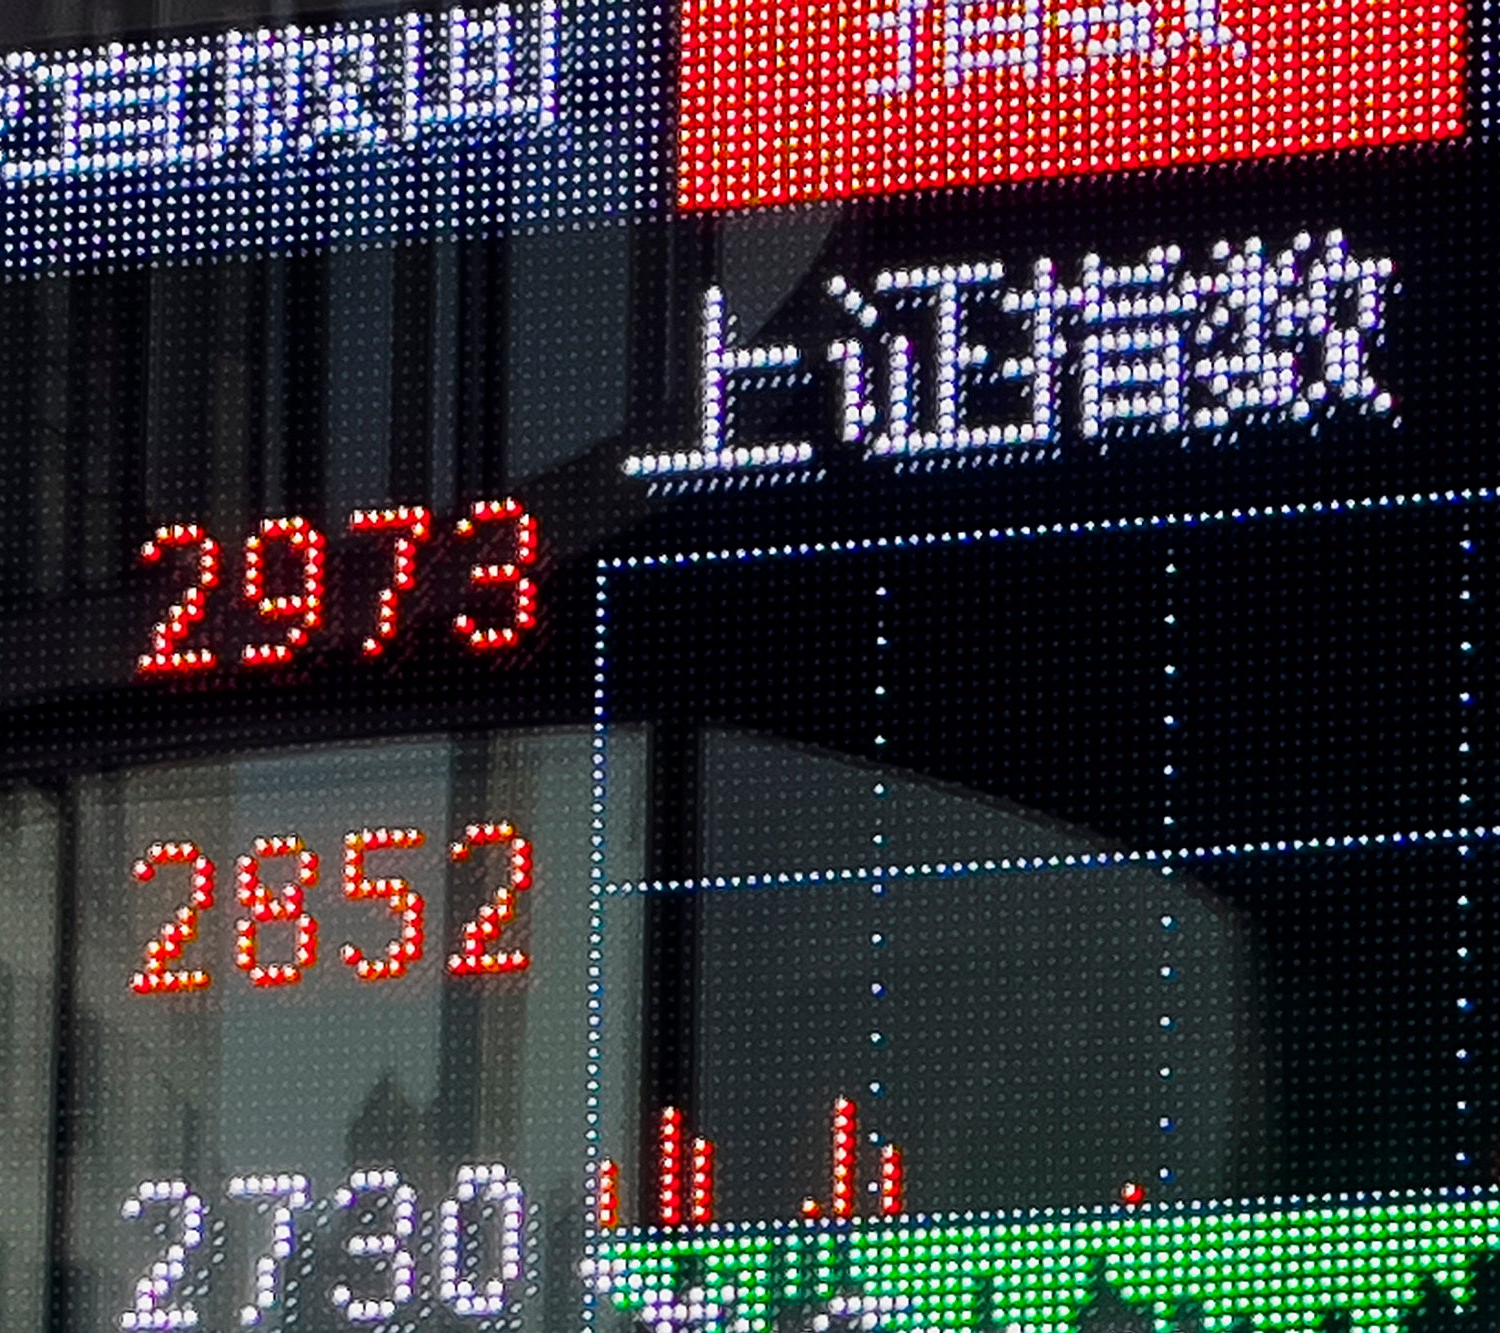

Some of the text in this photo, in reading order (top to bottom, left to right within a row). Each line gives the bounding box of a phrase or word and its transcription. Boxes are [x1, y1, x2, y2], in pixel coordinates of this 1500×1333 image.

[620, 230, 1395, 482] 上证指数
[138, 497, 538, 673] 2973
[128, 820, 534, 995] 2852
[119, 1163, 526, 1332] 2730
